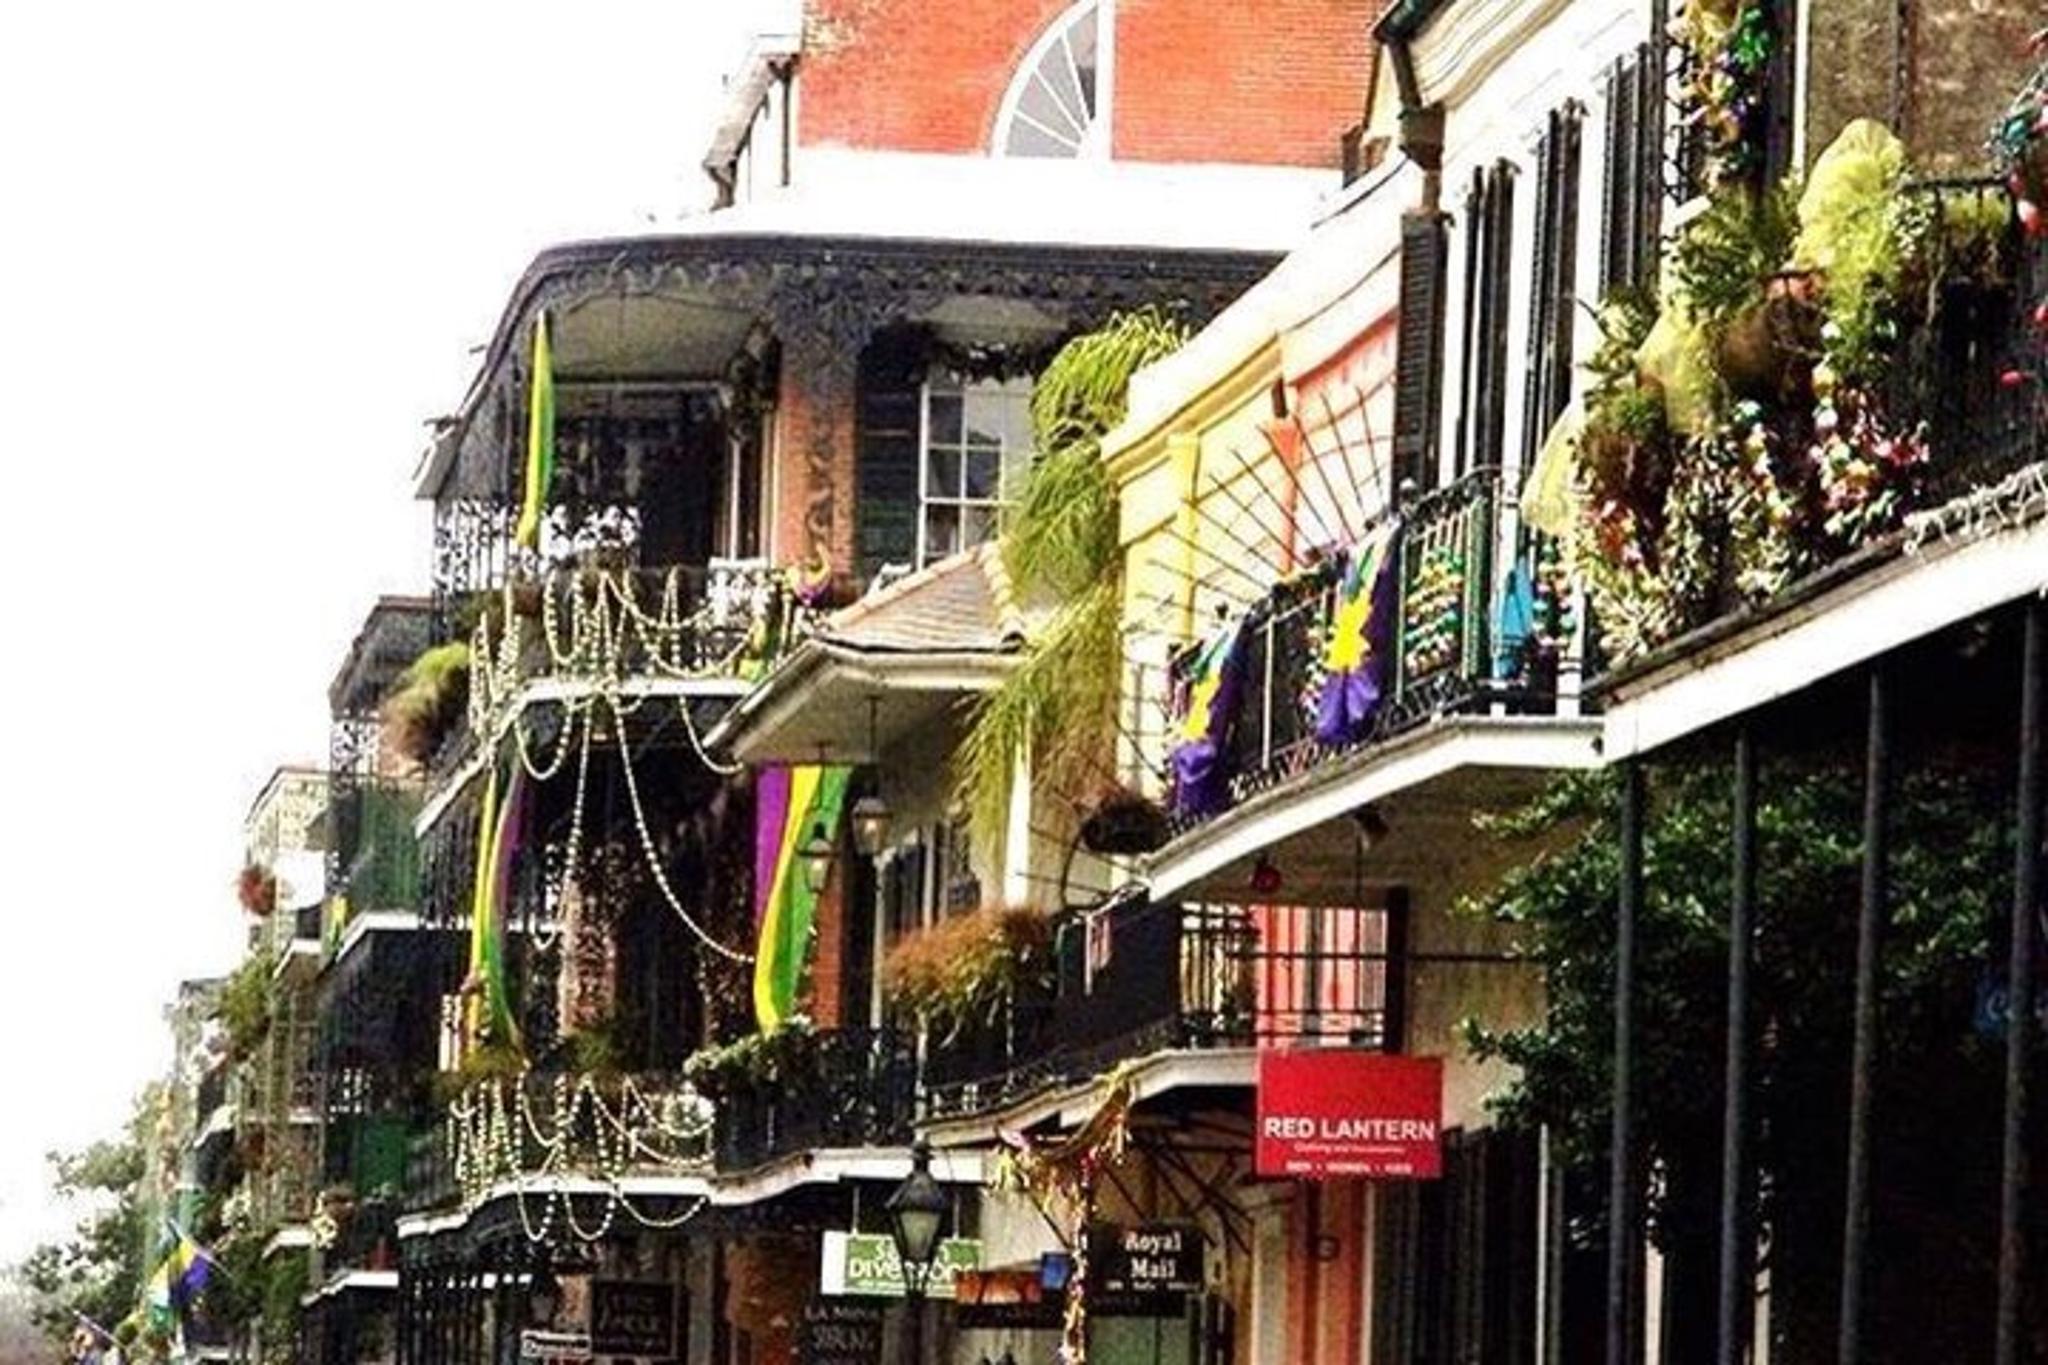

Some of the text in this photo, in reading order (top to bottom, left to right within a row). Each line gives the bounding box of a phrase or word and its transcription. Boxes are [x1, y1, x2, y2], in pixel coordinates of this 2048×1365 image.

[1264, 1116, 1436, 1142] RED LANTERN
[1125, 1230, 1181, 1256] Royal
[1130, 1256, 1176, 1279] Mail
